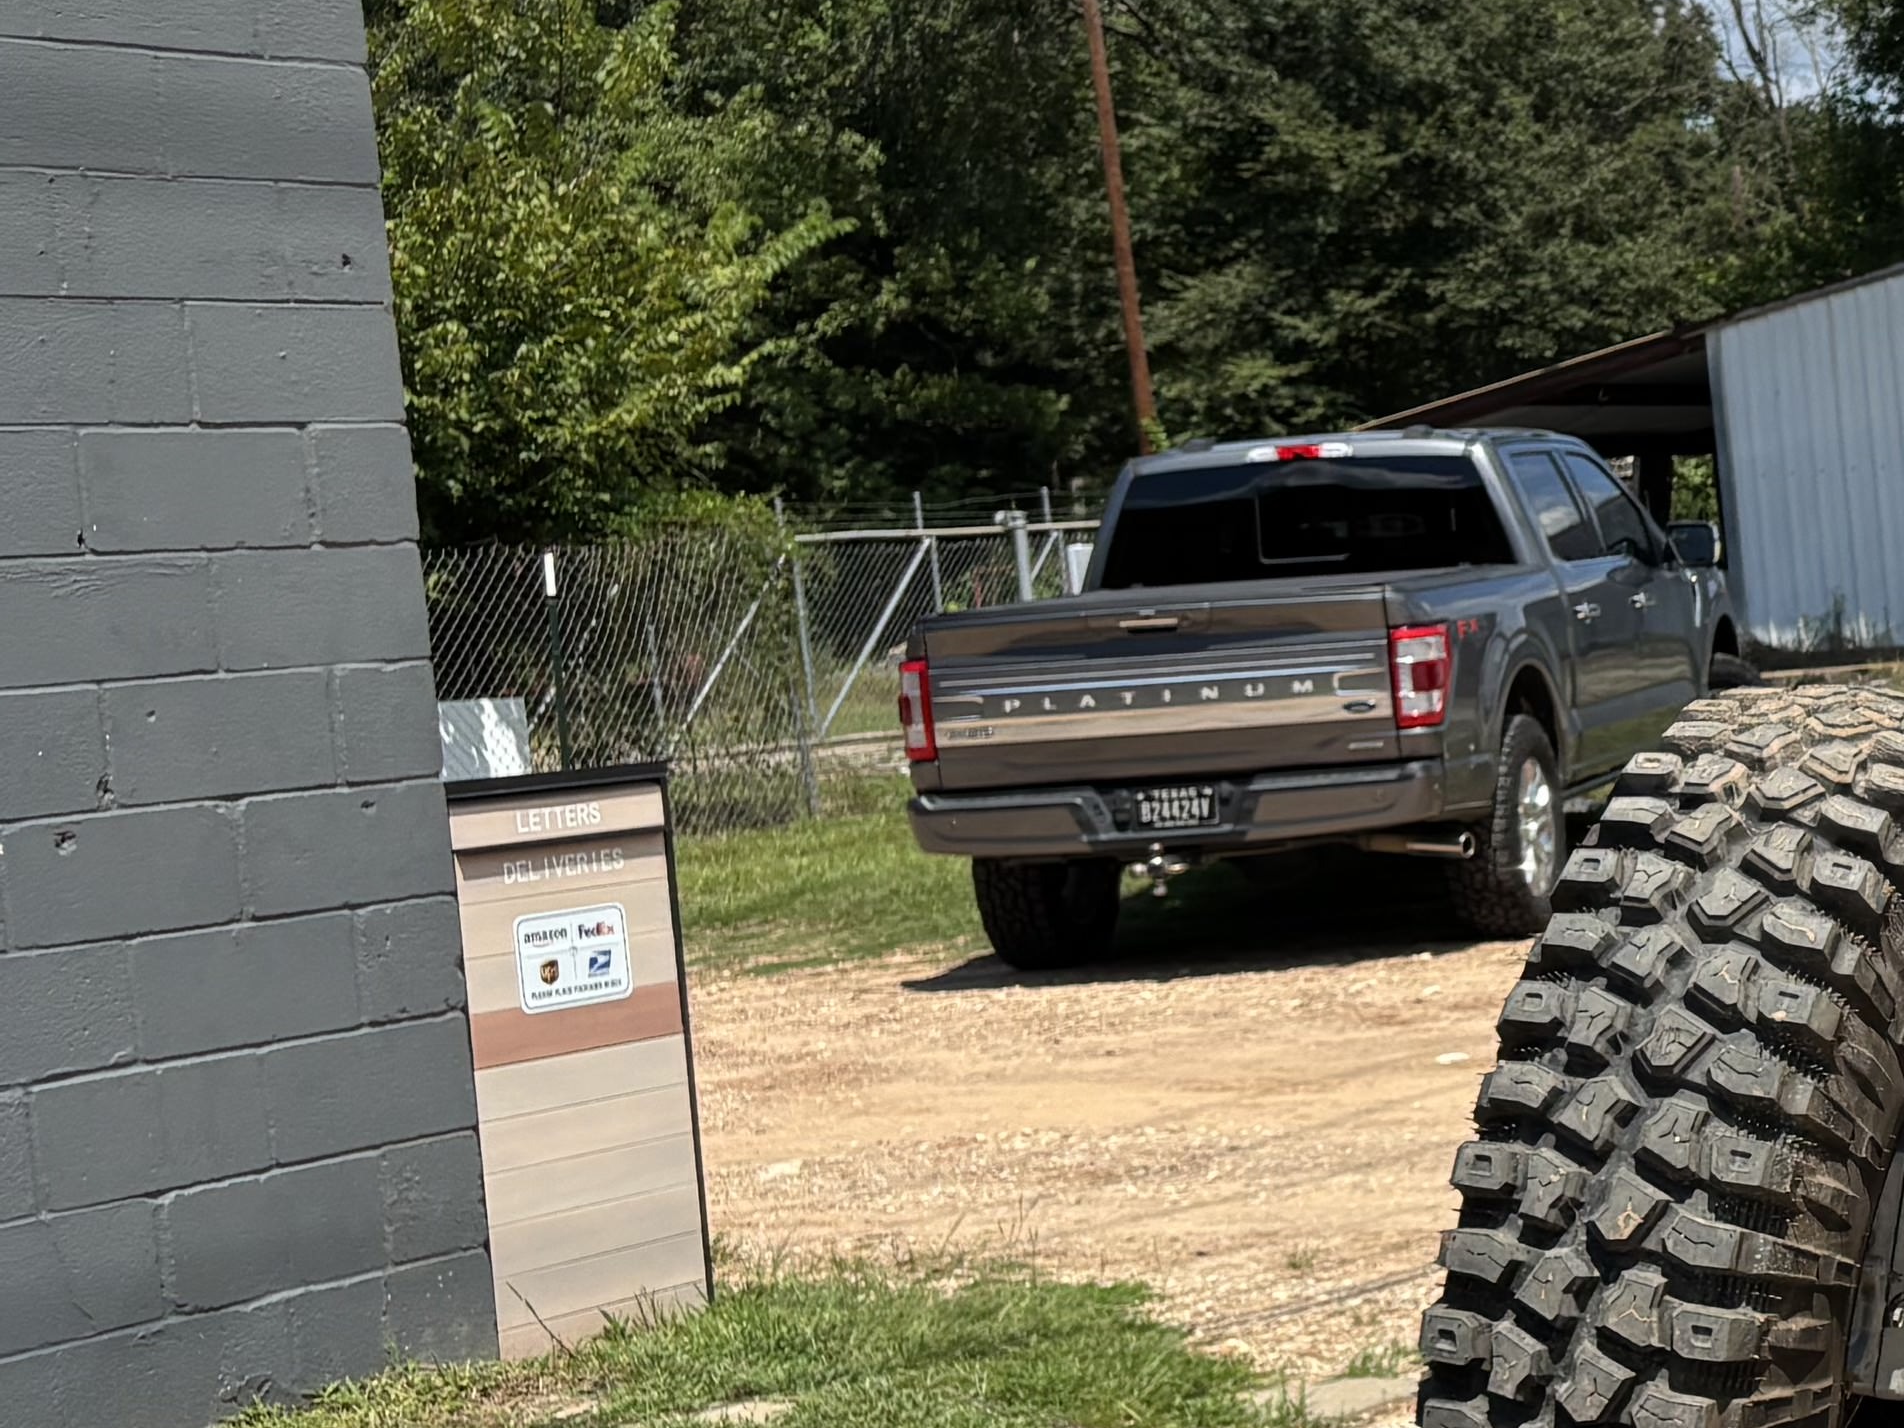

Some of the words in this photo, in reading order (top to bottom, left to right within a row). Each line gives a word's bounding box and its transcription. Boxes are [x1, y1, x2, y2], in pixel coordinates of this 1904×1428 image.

[1003, 679, 1315, 714] PLATINUM
[515, 801, 602, 833] LETTERS
[503, 847, 625, 885] DELIVERIES
